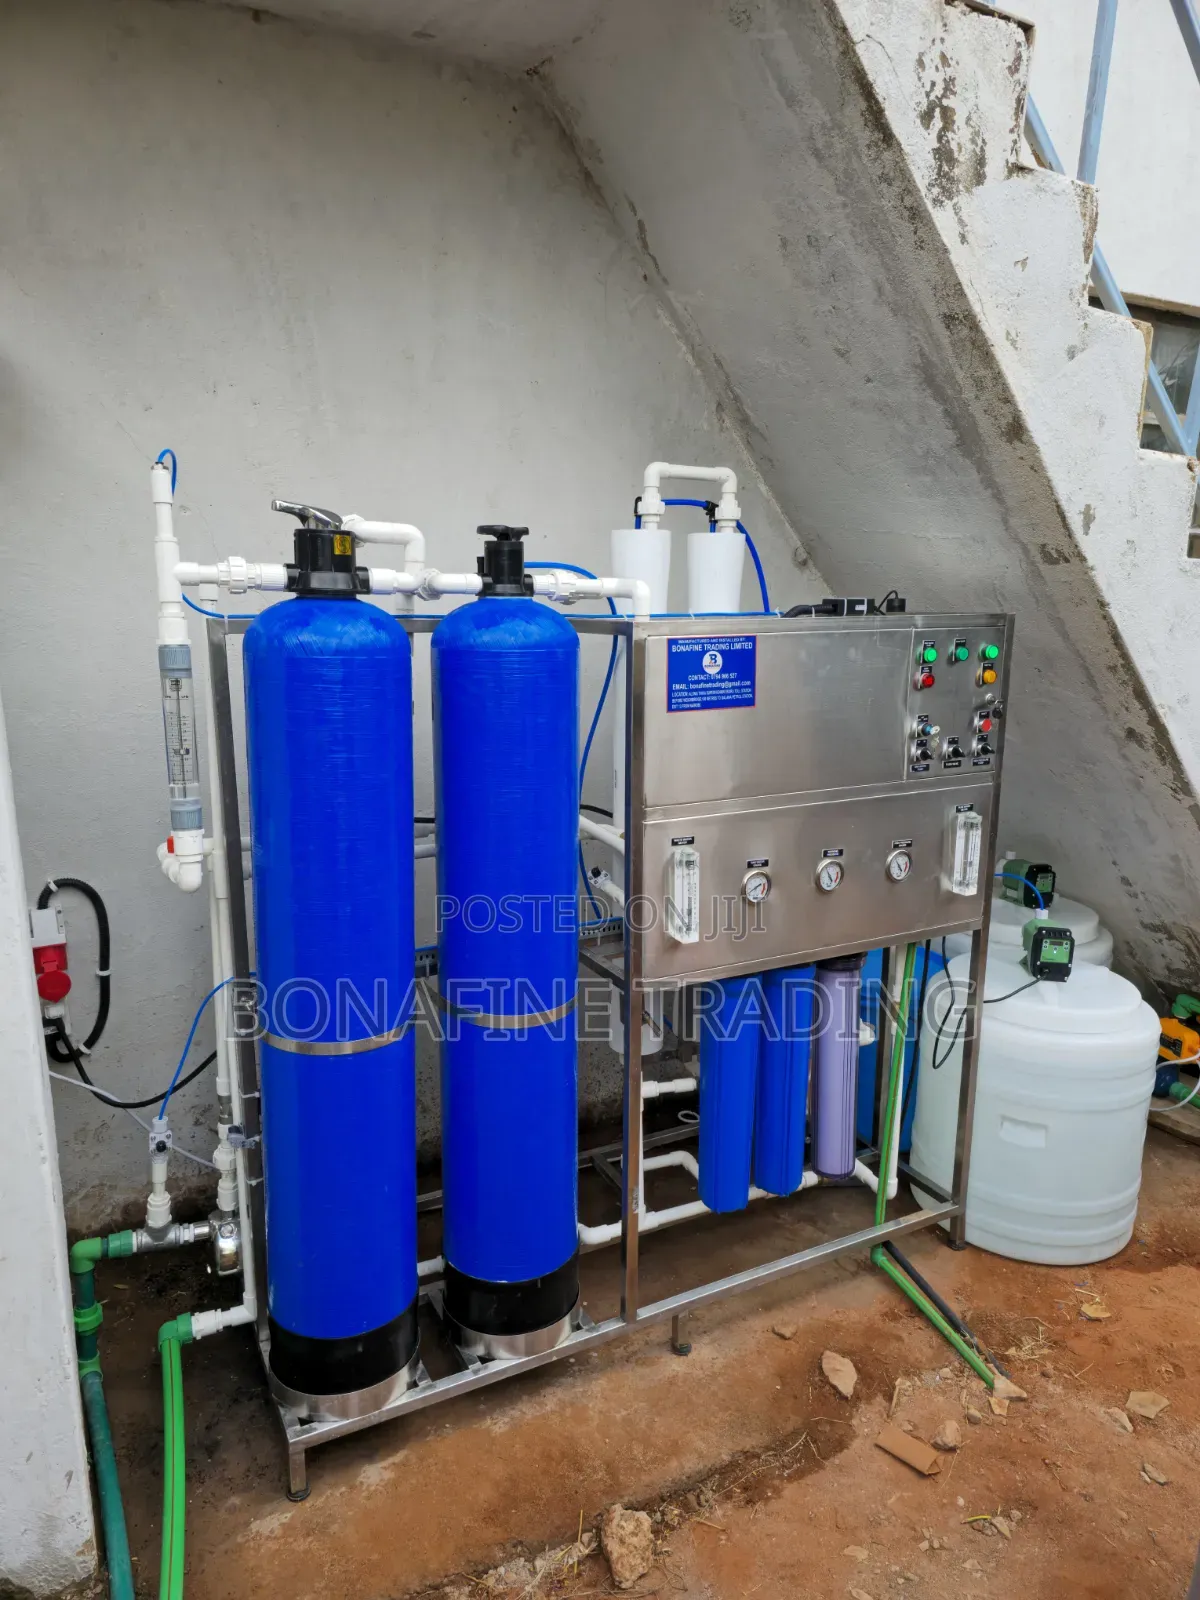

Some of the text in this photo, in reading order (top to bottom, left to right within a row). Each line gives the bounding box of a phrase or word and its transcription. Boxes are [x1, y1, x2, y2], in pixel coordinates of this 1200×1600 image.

[672, 642, 753, 652] BONAFINE TRADING LIMITED
